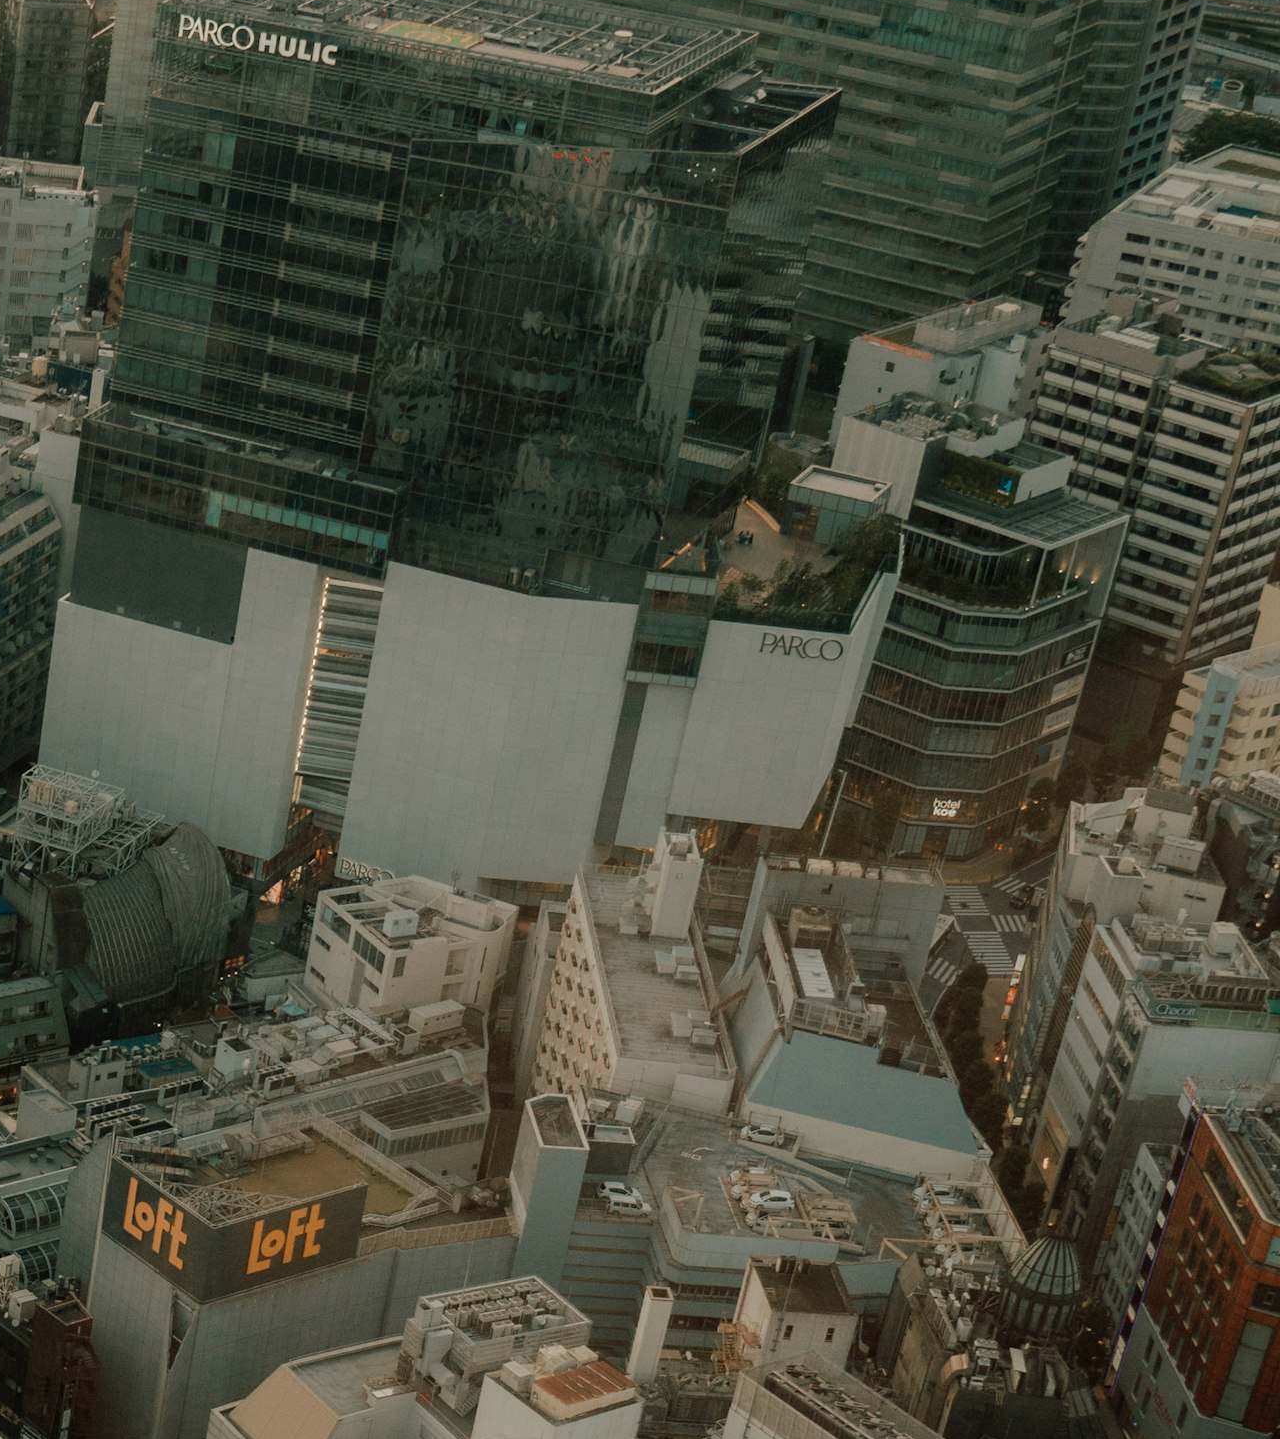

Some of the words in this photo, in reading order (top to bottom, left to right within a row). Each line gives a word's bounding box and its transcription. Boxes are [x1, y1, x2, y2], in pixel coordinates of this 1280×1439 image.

[178, 14, 254, 51] PARCO
[258, 35, 338, 66] HULIC
[759, 633, 844, 662] PARCO
[933, 798, 962, 810] hotel
[1155, 1004, 1196, 1017] Chacott
